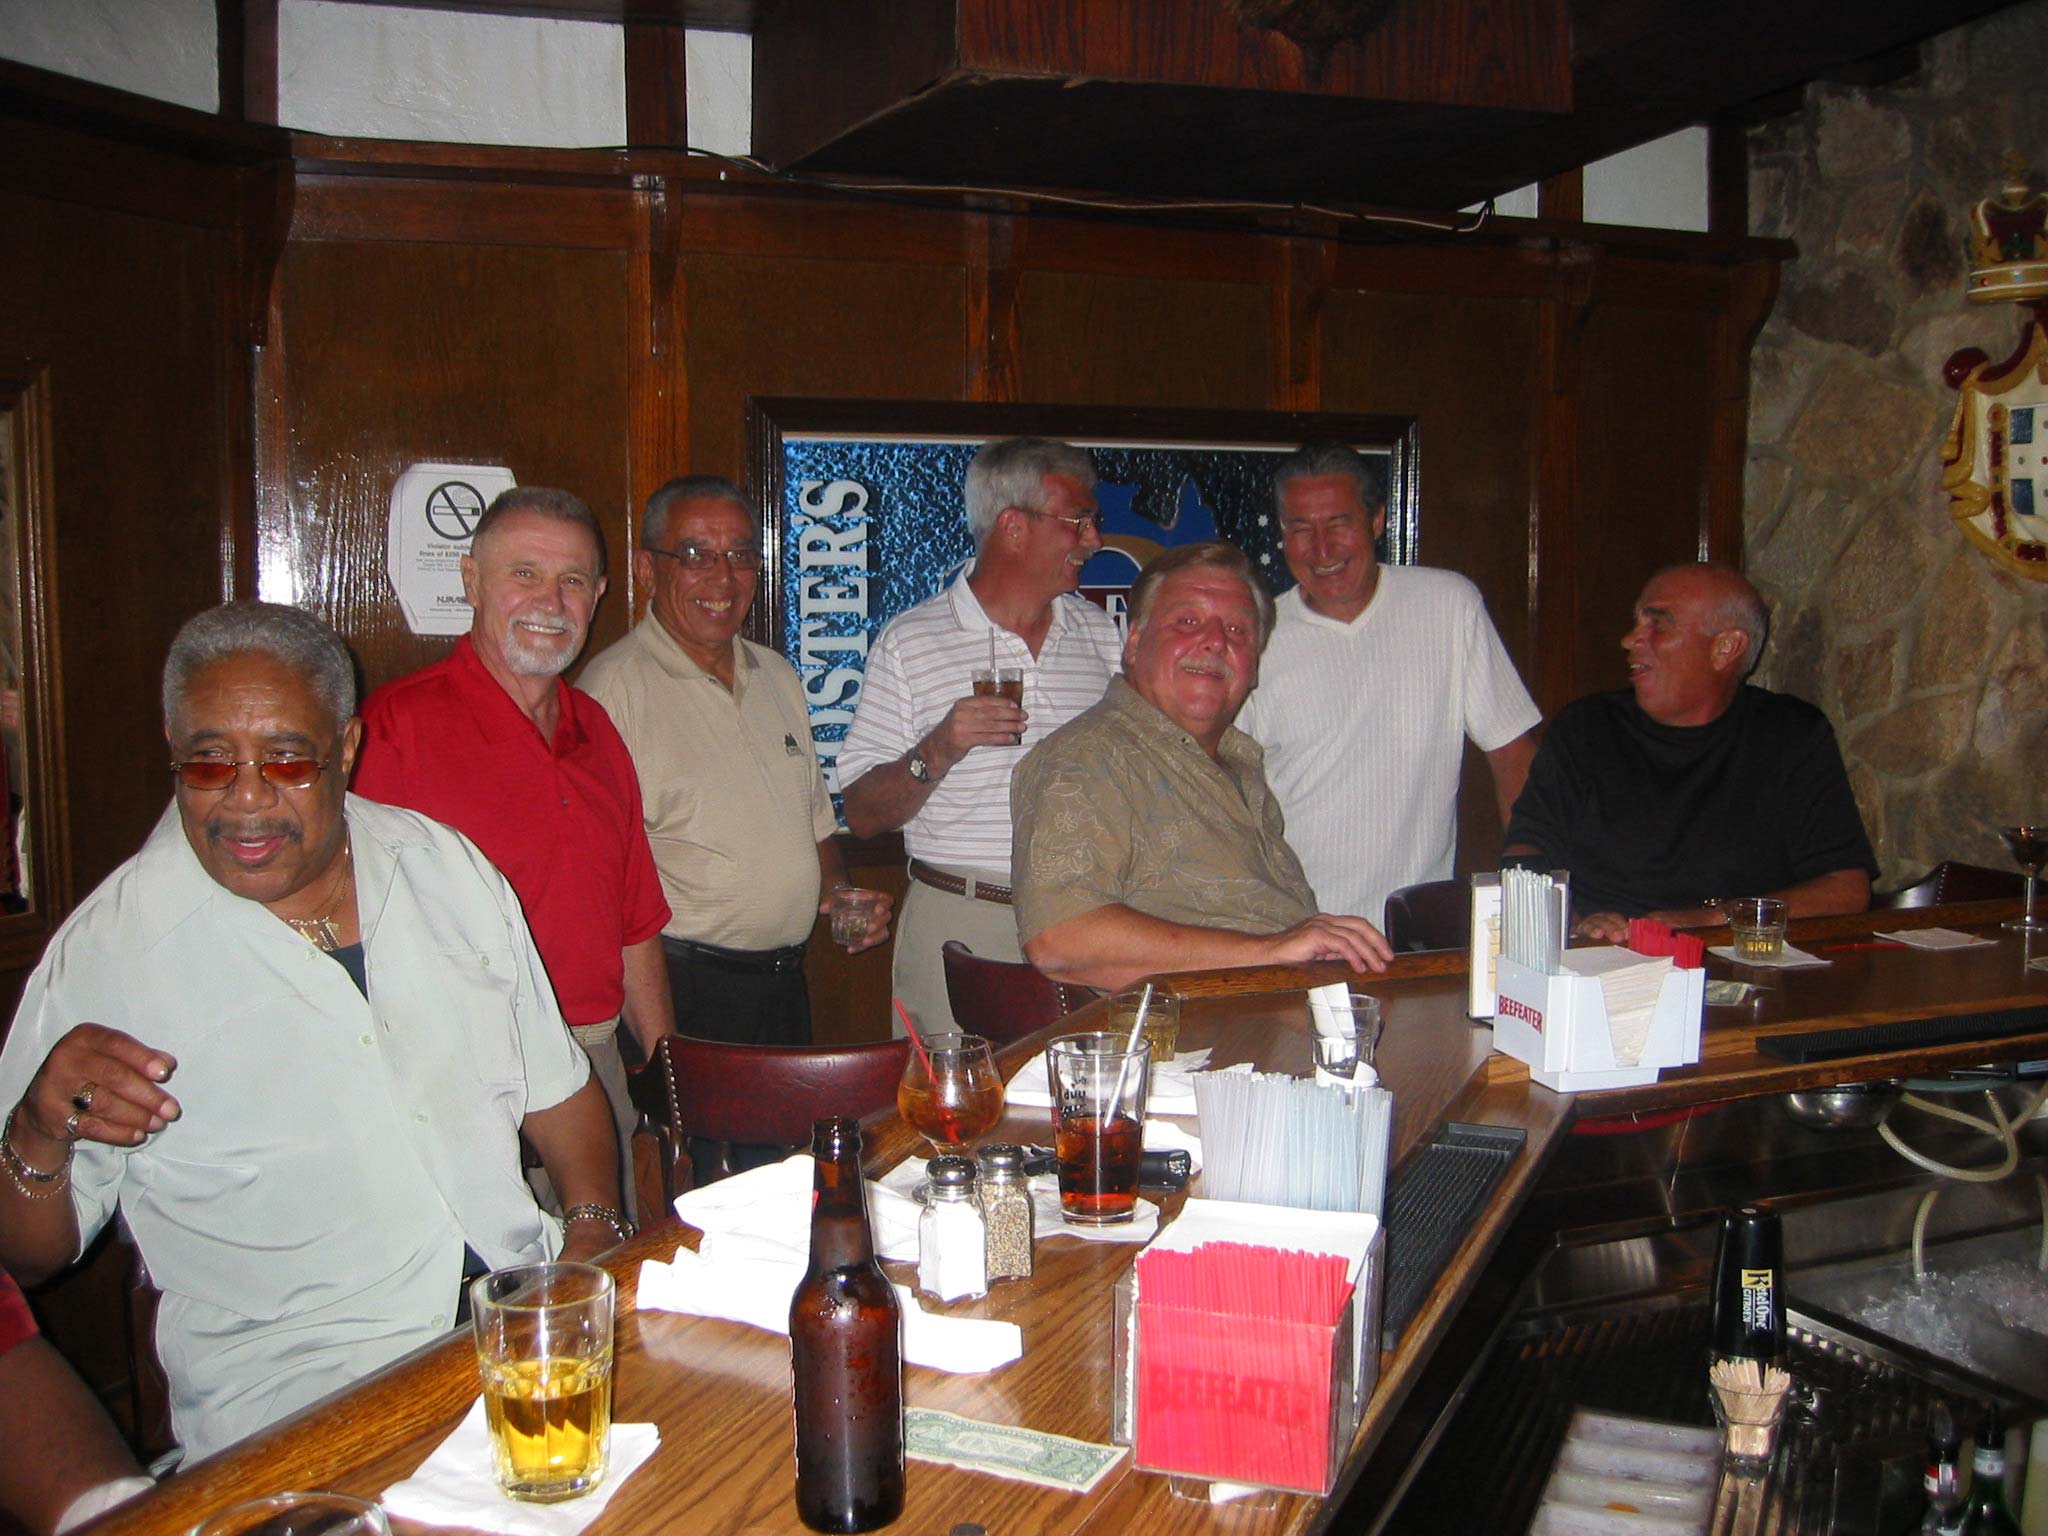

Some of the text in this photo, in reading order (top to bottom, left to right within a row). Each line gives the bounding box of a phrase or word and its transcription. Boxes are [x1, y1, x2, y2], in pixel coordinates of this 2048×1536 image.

[1499, 994, 1543, 1034] BEEFEATER
[1745, 1271, 1770, 1328] Ketel One
